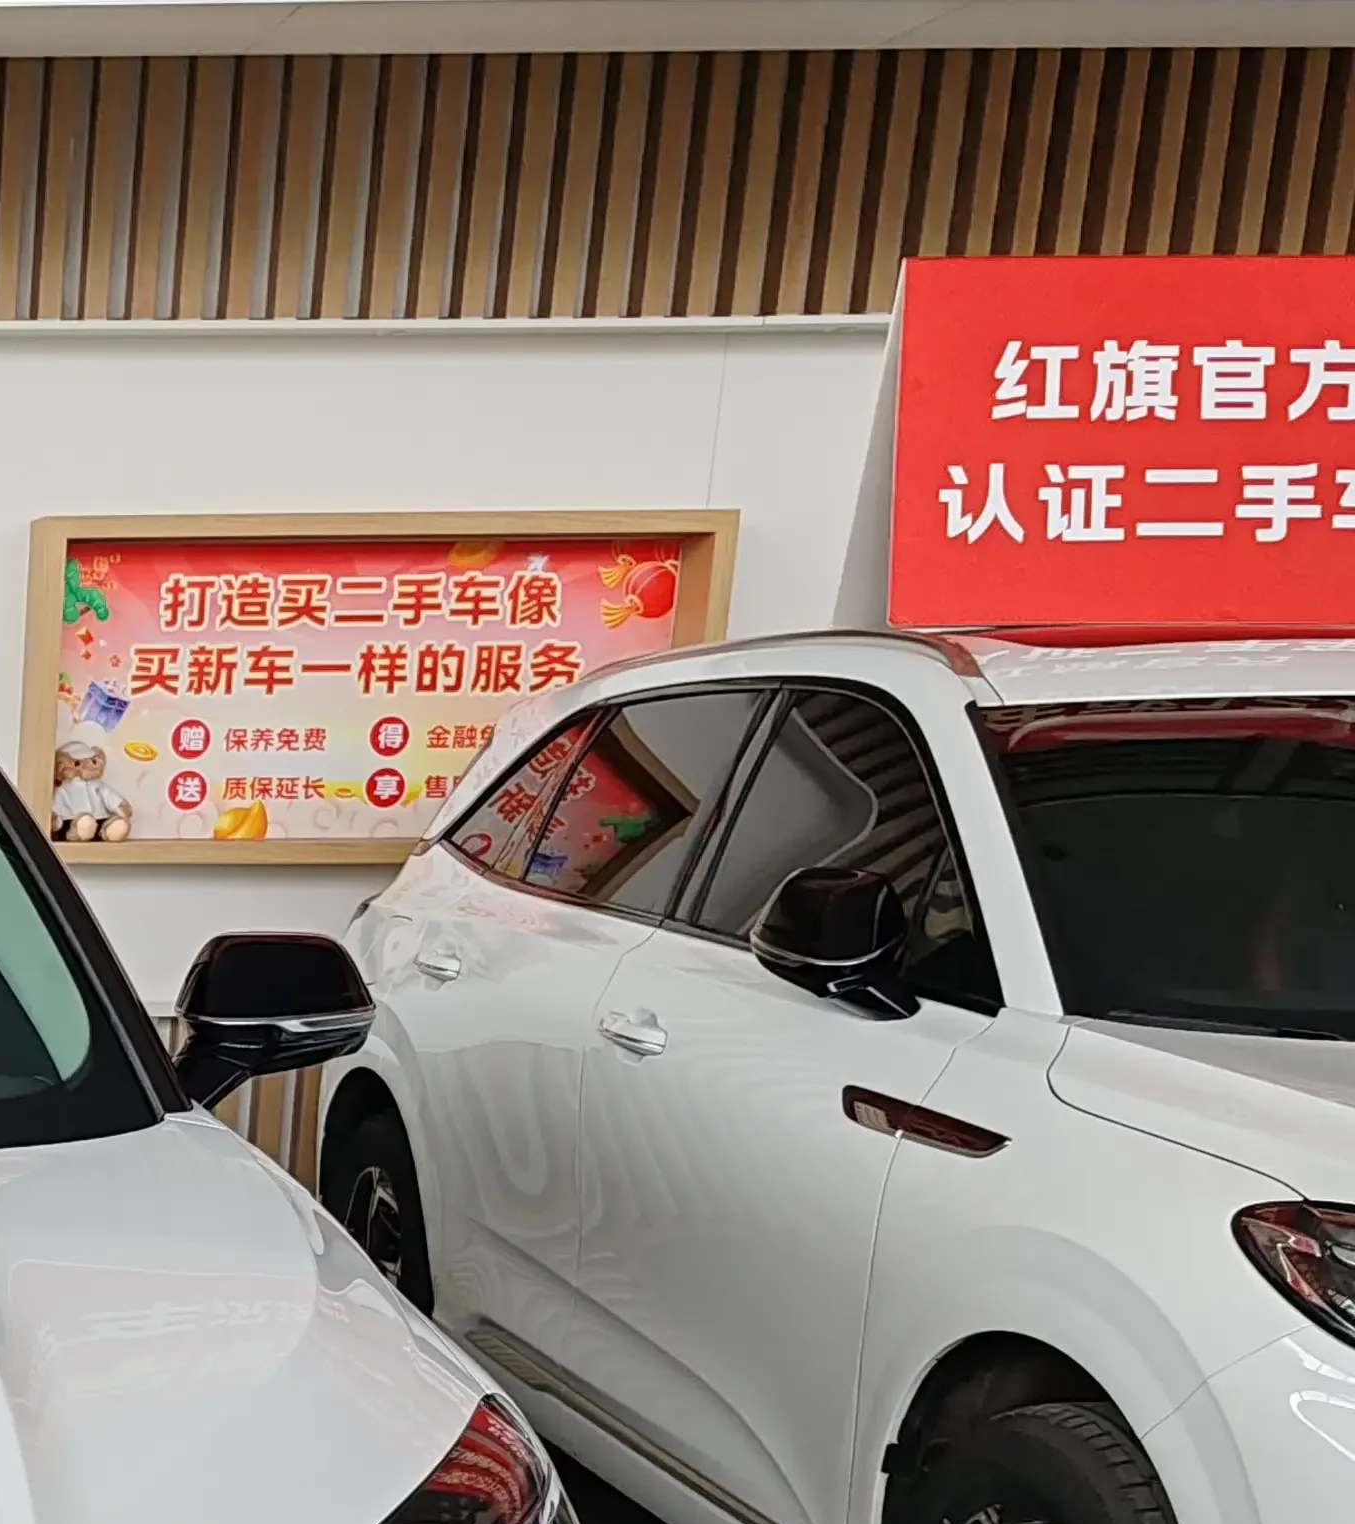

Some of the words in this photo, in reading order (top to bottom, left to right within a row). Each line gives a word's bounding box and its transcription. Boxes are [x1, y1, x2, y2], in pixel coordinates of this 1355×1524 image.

[991, 340, 1355, 422] 红旗官方
[938, 462, 1355, 544] 认证二手
[163, 575, 559, 628] 打造买二手车像
[130, 642, 581, 696] 买新车一样的服务
[179, 726, 205, 751] 赠
[224, 728, 326, 752] 保养免费
[378, 723, 403, 749] 得
[176, 777, 201, 802] 送
[222, 776, 325, 800] 质保延长
[374, 775, 399, 800] 享
